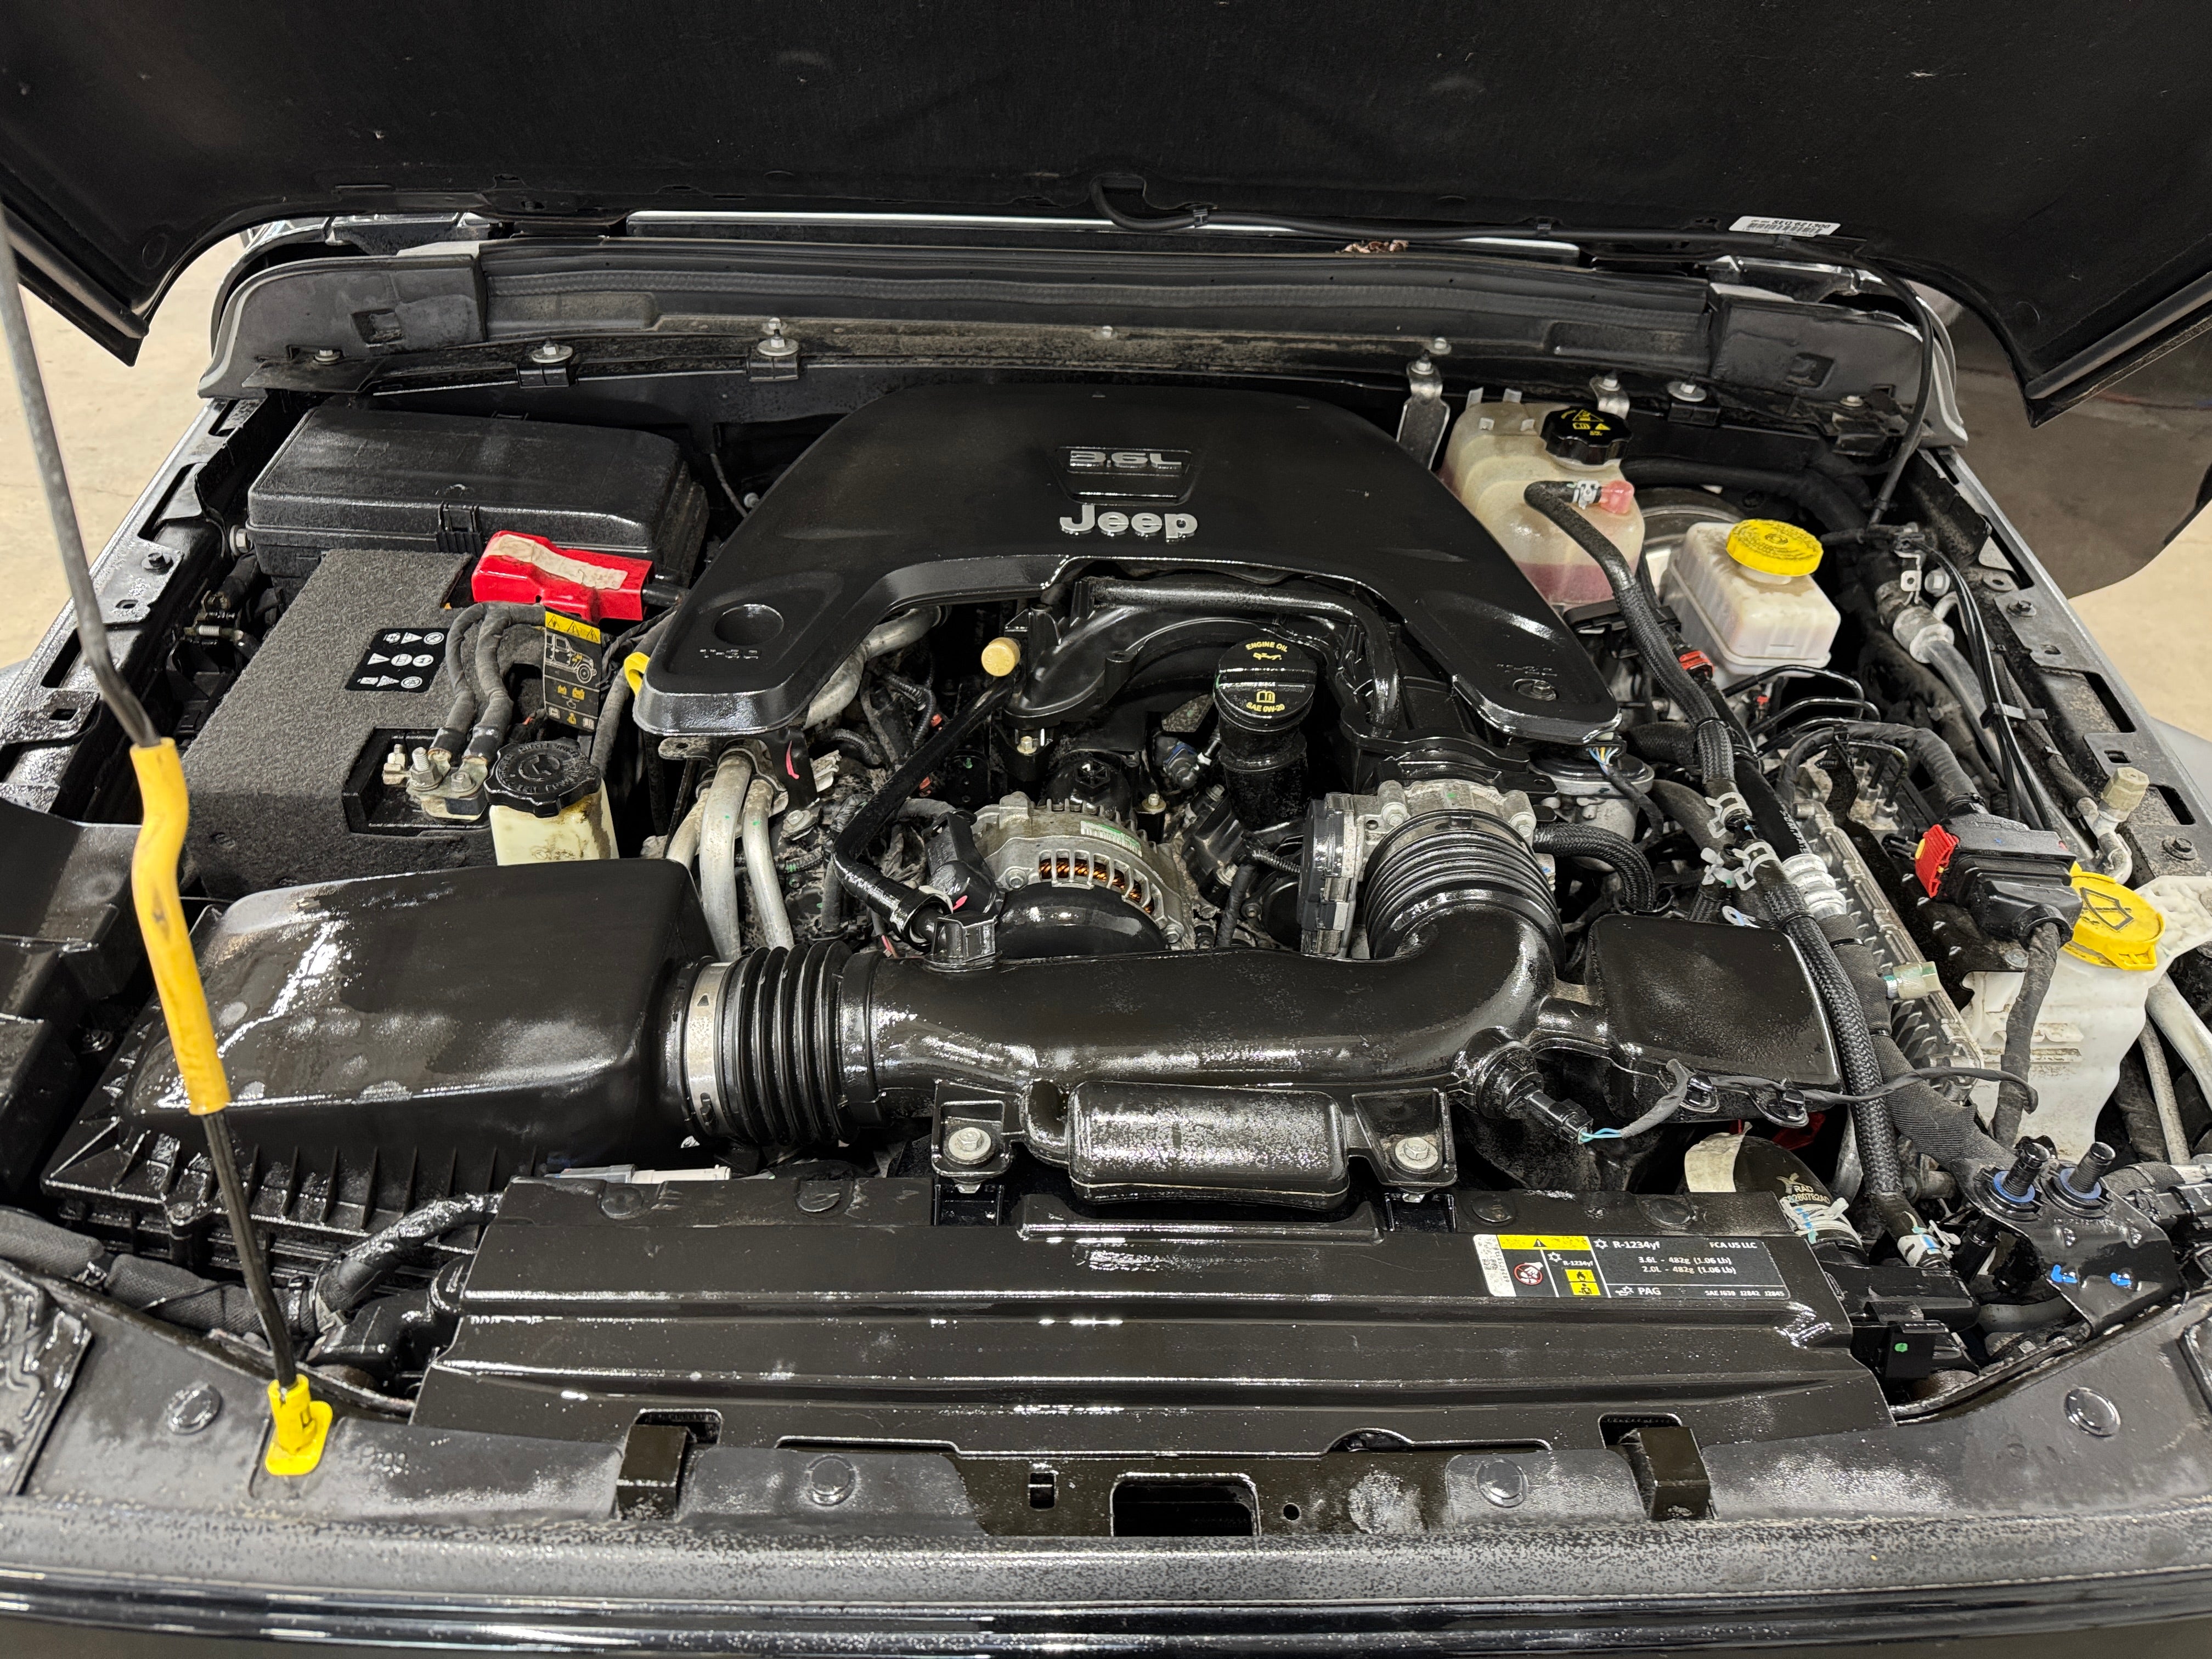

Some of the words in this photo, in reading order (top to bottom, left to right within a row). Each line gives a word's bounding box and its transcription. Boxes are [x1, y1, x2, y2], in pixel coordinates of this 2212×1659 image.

[1070, 450, 1182, 469] 3.6L
[1059, 504, 1198, 541] Jeep
[1245, 641, 1275, 651] ENGINE
[1276, 643, 1288, 652] OIL
[1246, 702, 1262, 712] SAE
[1263, 703, 1285, 713] 0W-20
[1612, 1241, 1661, 1250] R-1234yf
[1638, 1287, 1662, 1295] PAG
